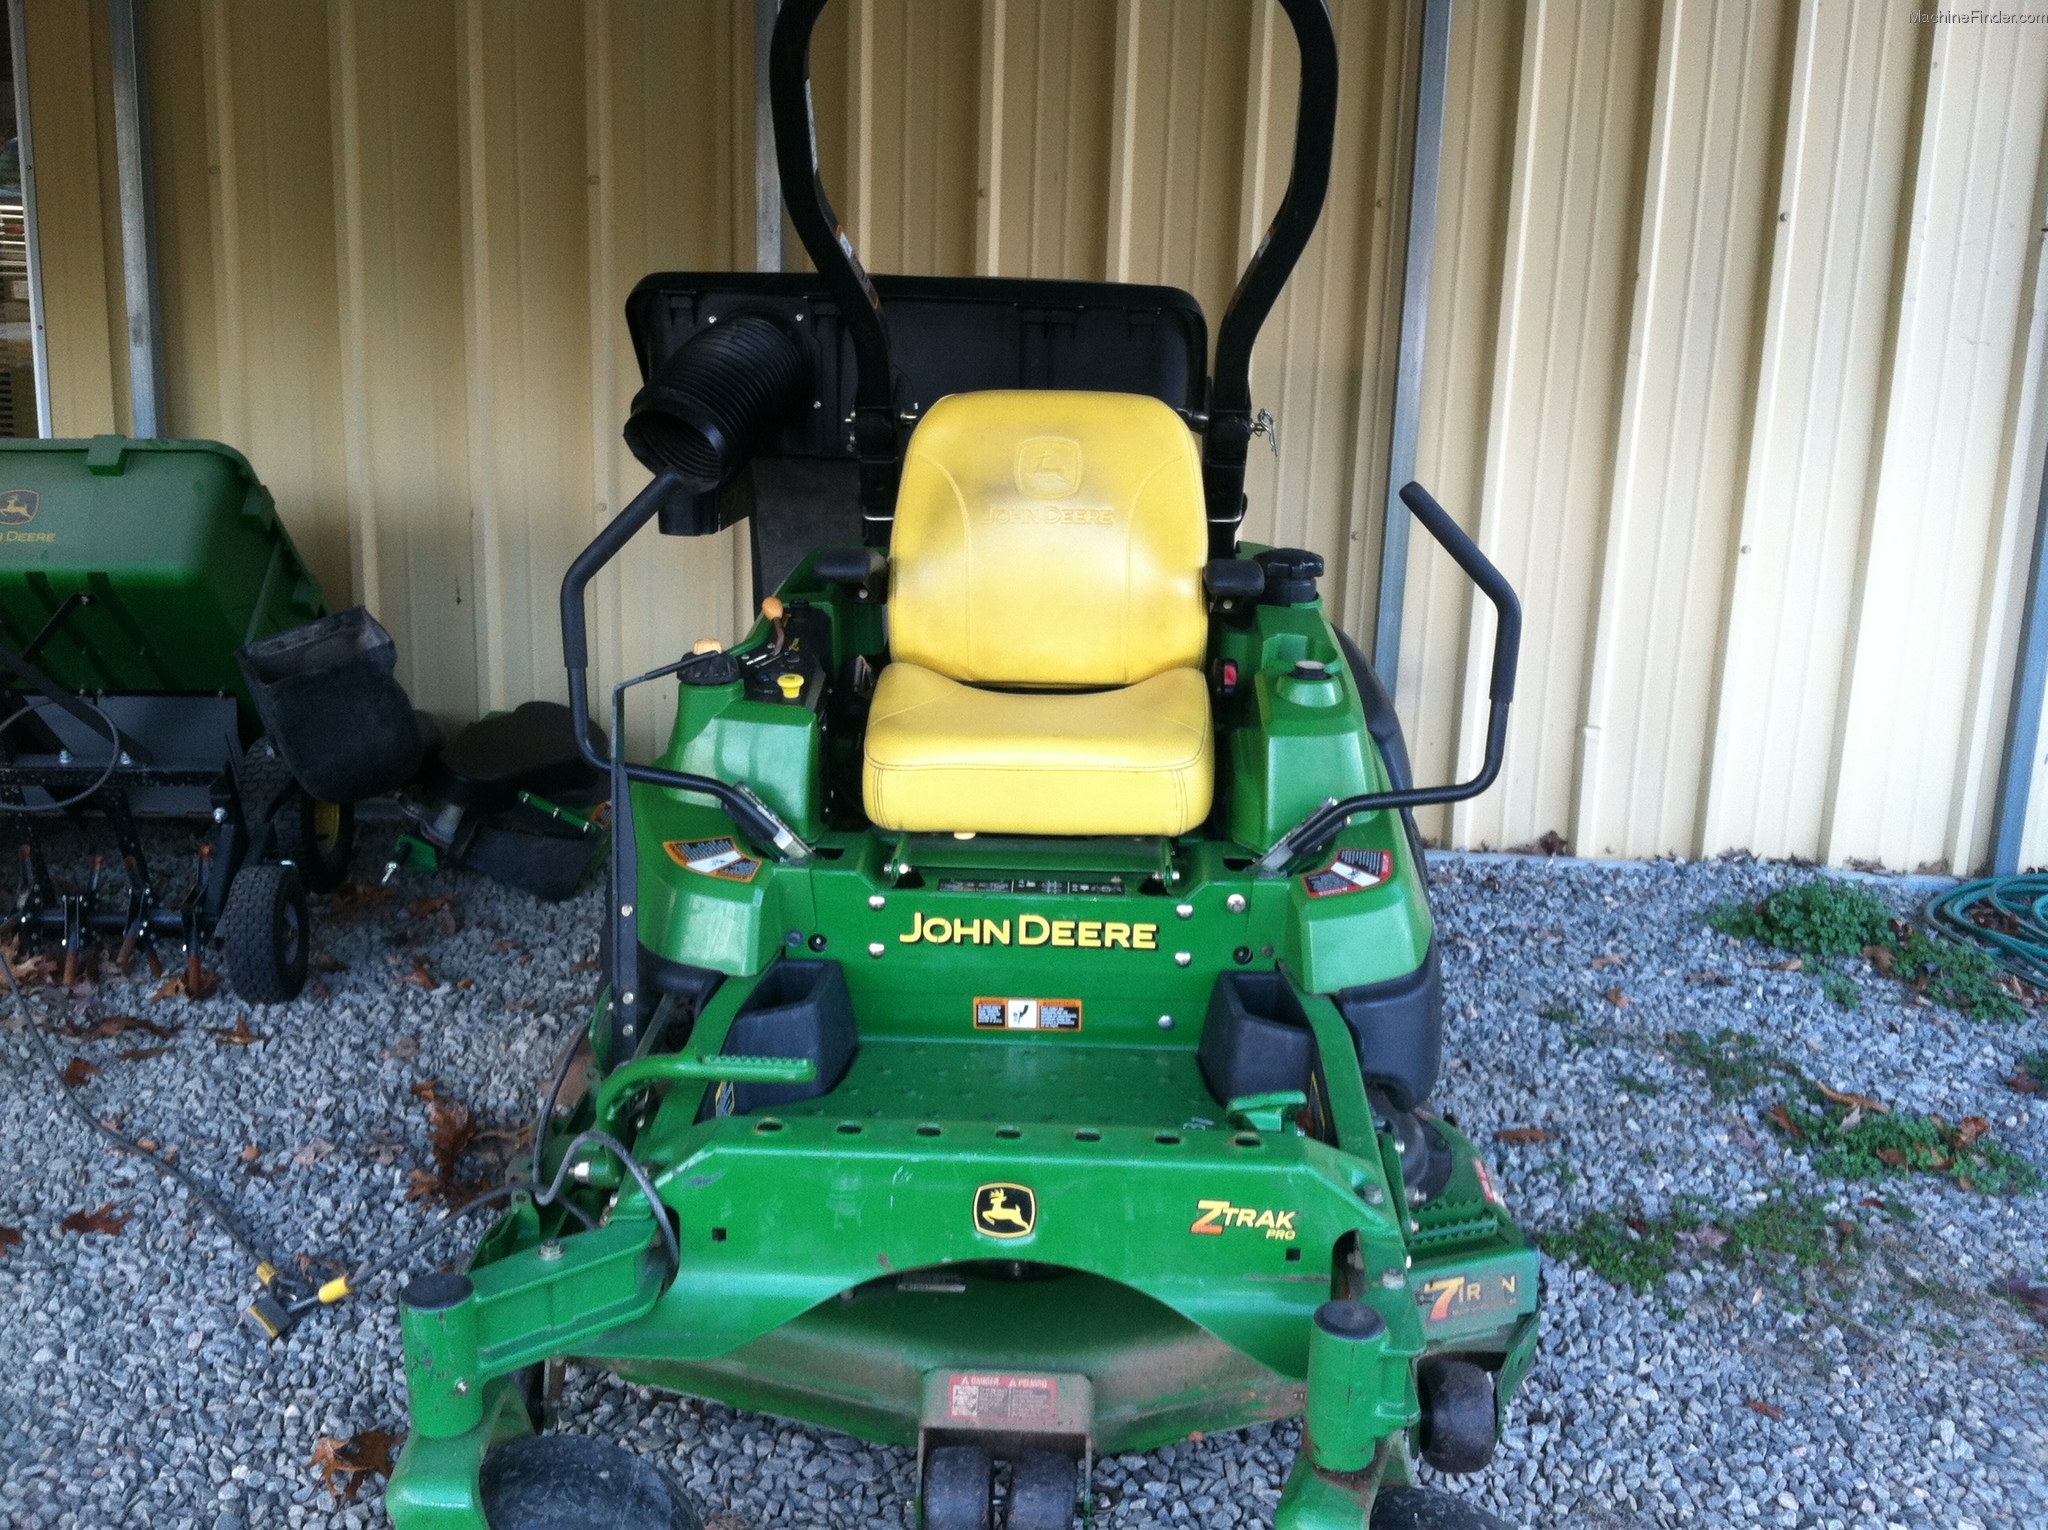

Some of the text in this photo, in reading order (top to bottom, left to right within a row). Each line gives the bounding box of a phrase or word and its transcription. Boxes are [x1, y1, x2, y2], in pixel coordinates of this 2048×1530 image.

[982, 506, 1115, 525] JOHN DEERE
[7, 531, 56, 541] DEERE
[899, 912, 1158, 949] JOHN DEERE
[1265, 1229, 1296, 1240] PRO
